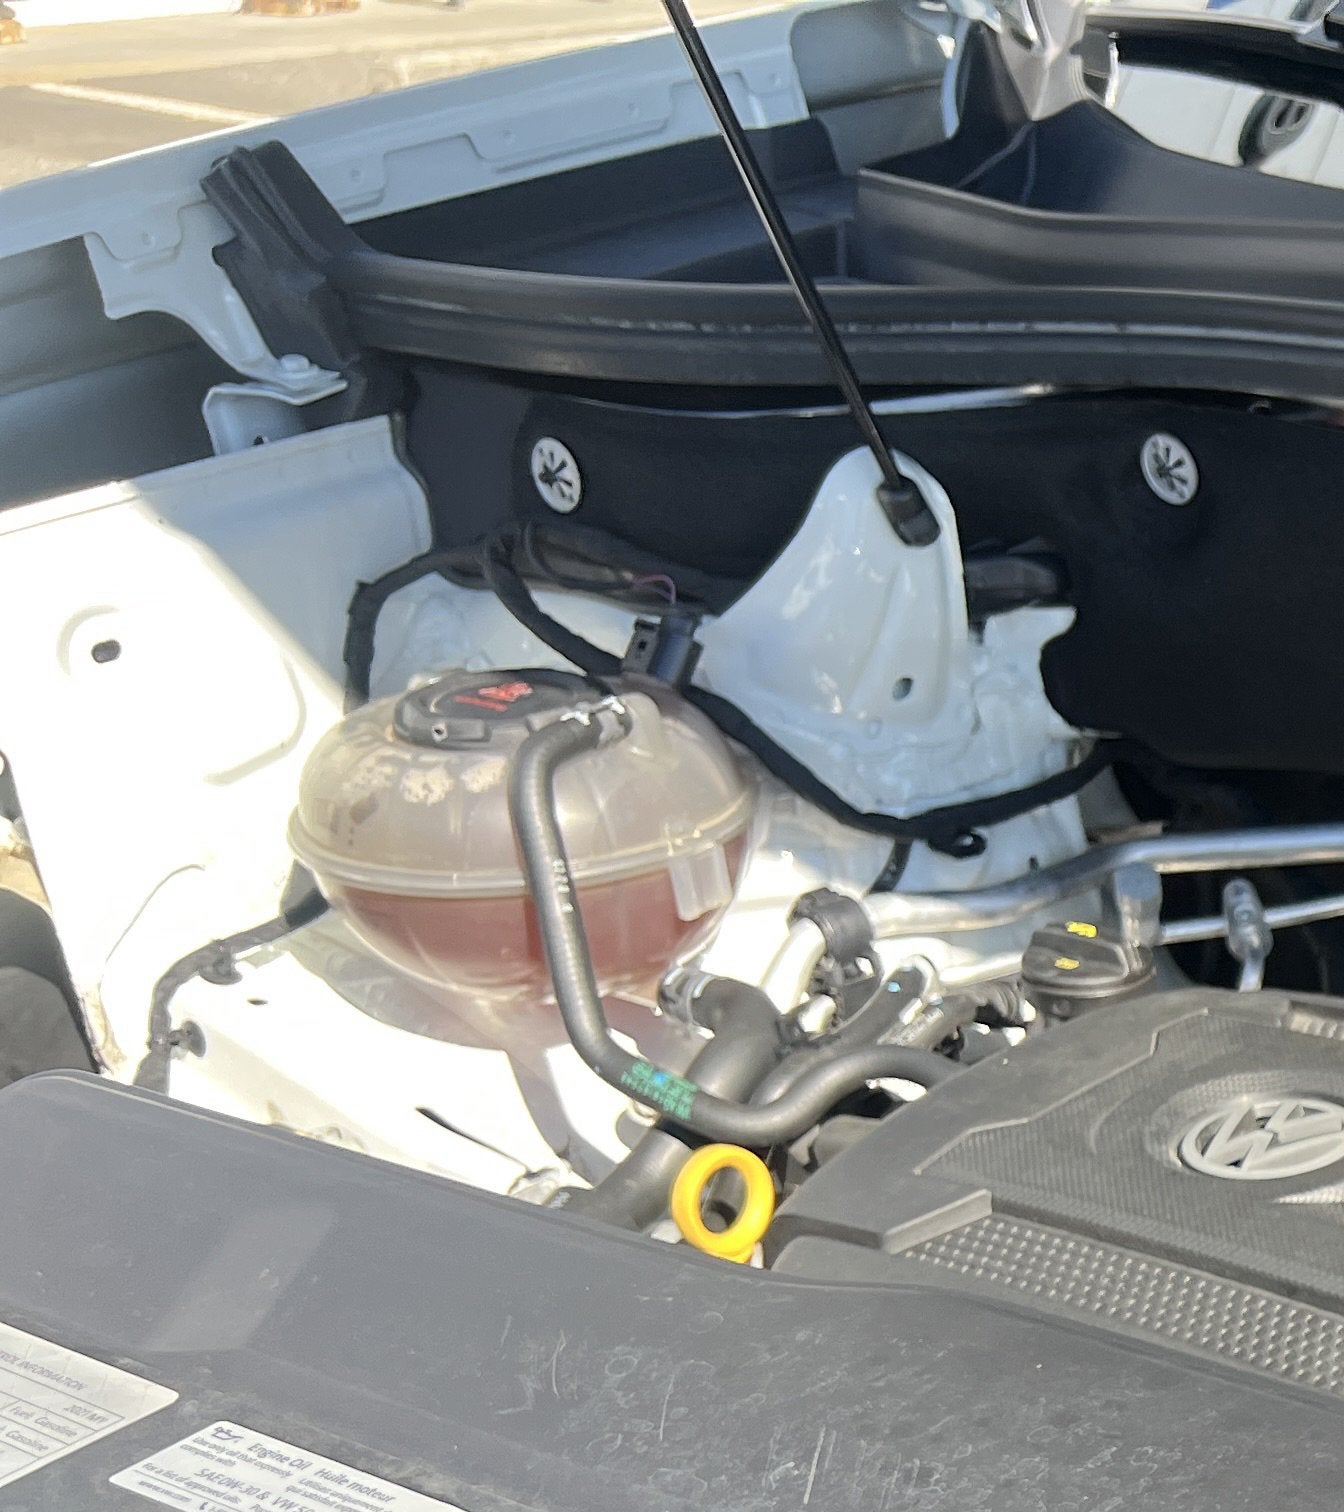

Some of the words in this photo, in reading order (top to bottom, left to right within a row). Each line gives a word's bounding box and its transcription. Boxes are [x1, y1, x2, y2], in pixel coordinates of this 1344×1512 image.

[193, 1468, 225, 1481] SAE
[270, 1497, 299, 1509] VW
[243, 1443, 294, 1464] Engine
[287, 1458, 312, 1469] Oil
[313, 1468, 354, 1484] Huile
[346, 1481, 398, 1502] moteur
